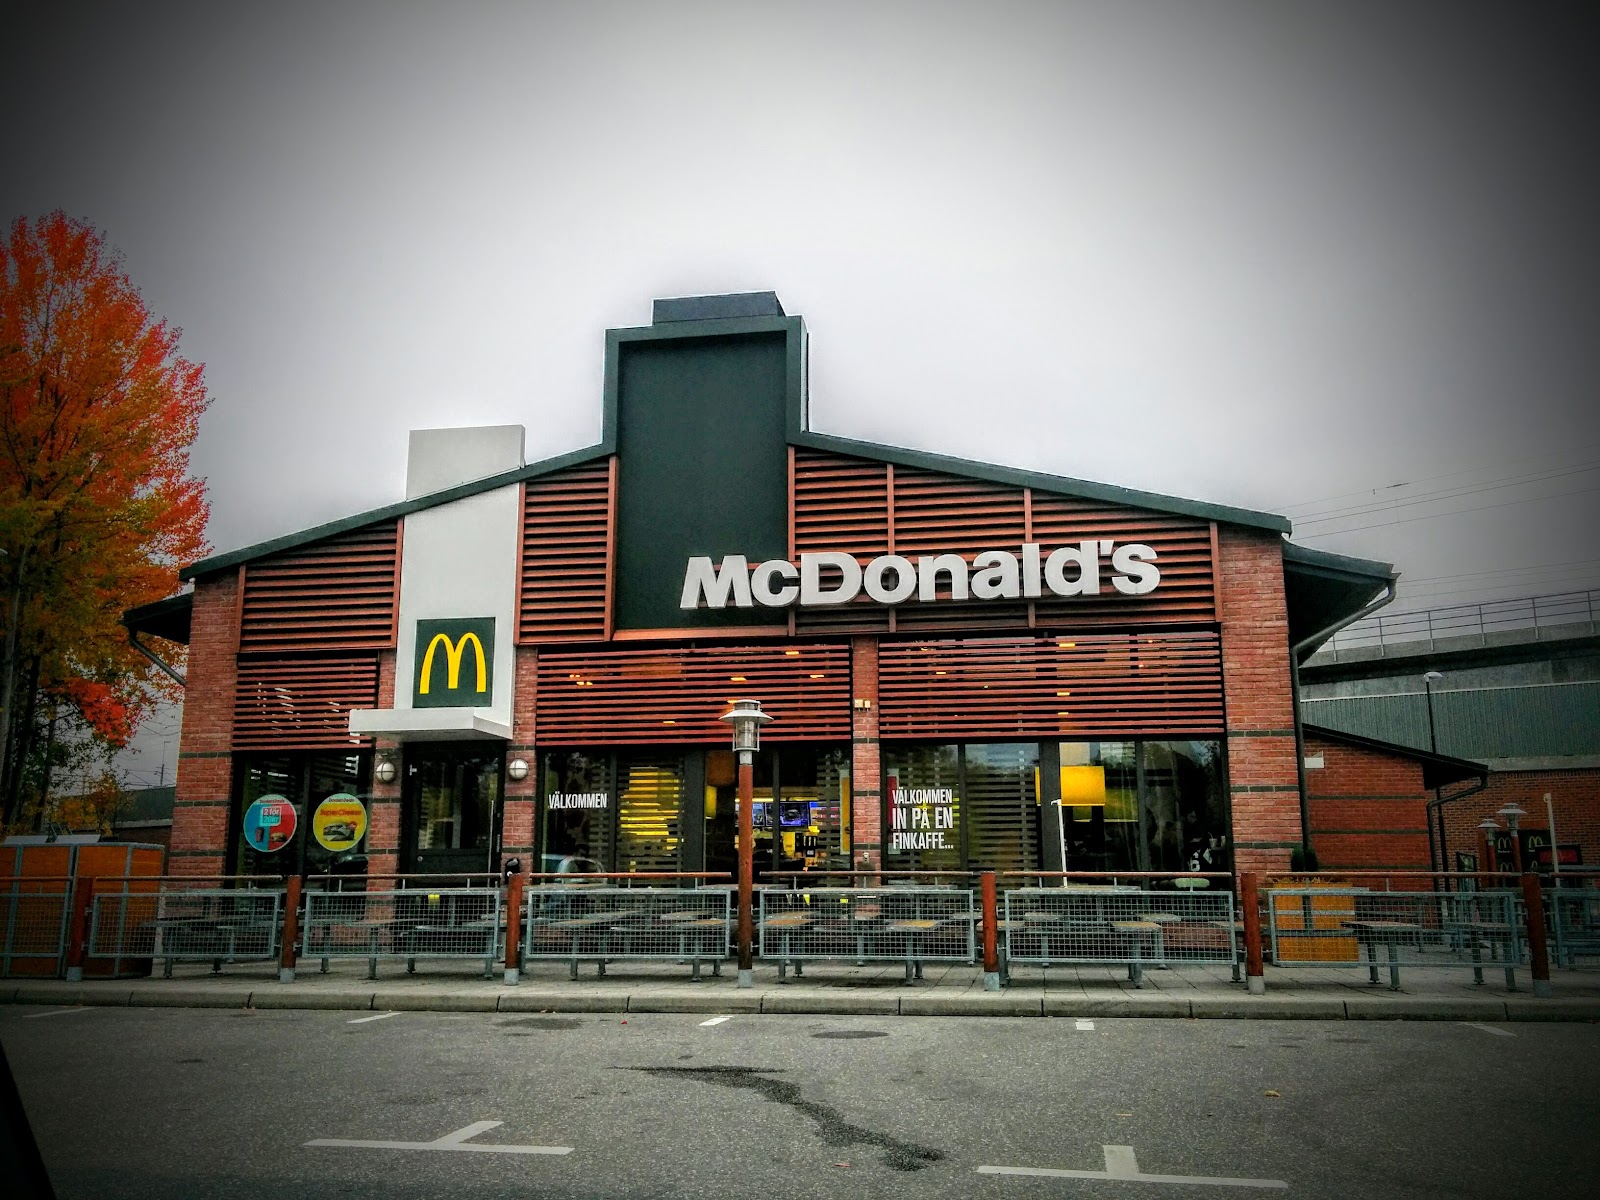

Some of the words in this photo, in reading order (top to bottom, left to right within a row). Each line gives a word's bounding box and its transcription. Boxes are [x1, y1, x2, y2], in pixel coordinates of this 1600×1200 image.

[679, 539, 1161, 610] McDonald's
[548, 790, 608, 809] VÄLKOMMEN
[892, 786, 953, 804] VÄLKOMMEN
[892, 807, 907, 829] IN
[912, 807, 930, 829] PÅ
[935, 807, 954, 829] EN
[892, 832, 954, 850] FINKAFFE...
